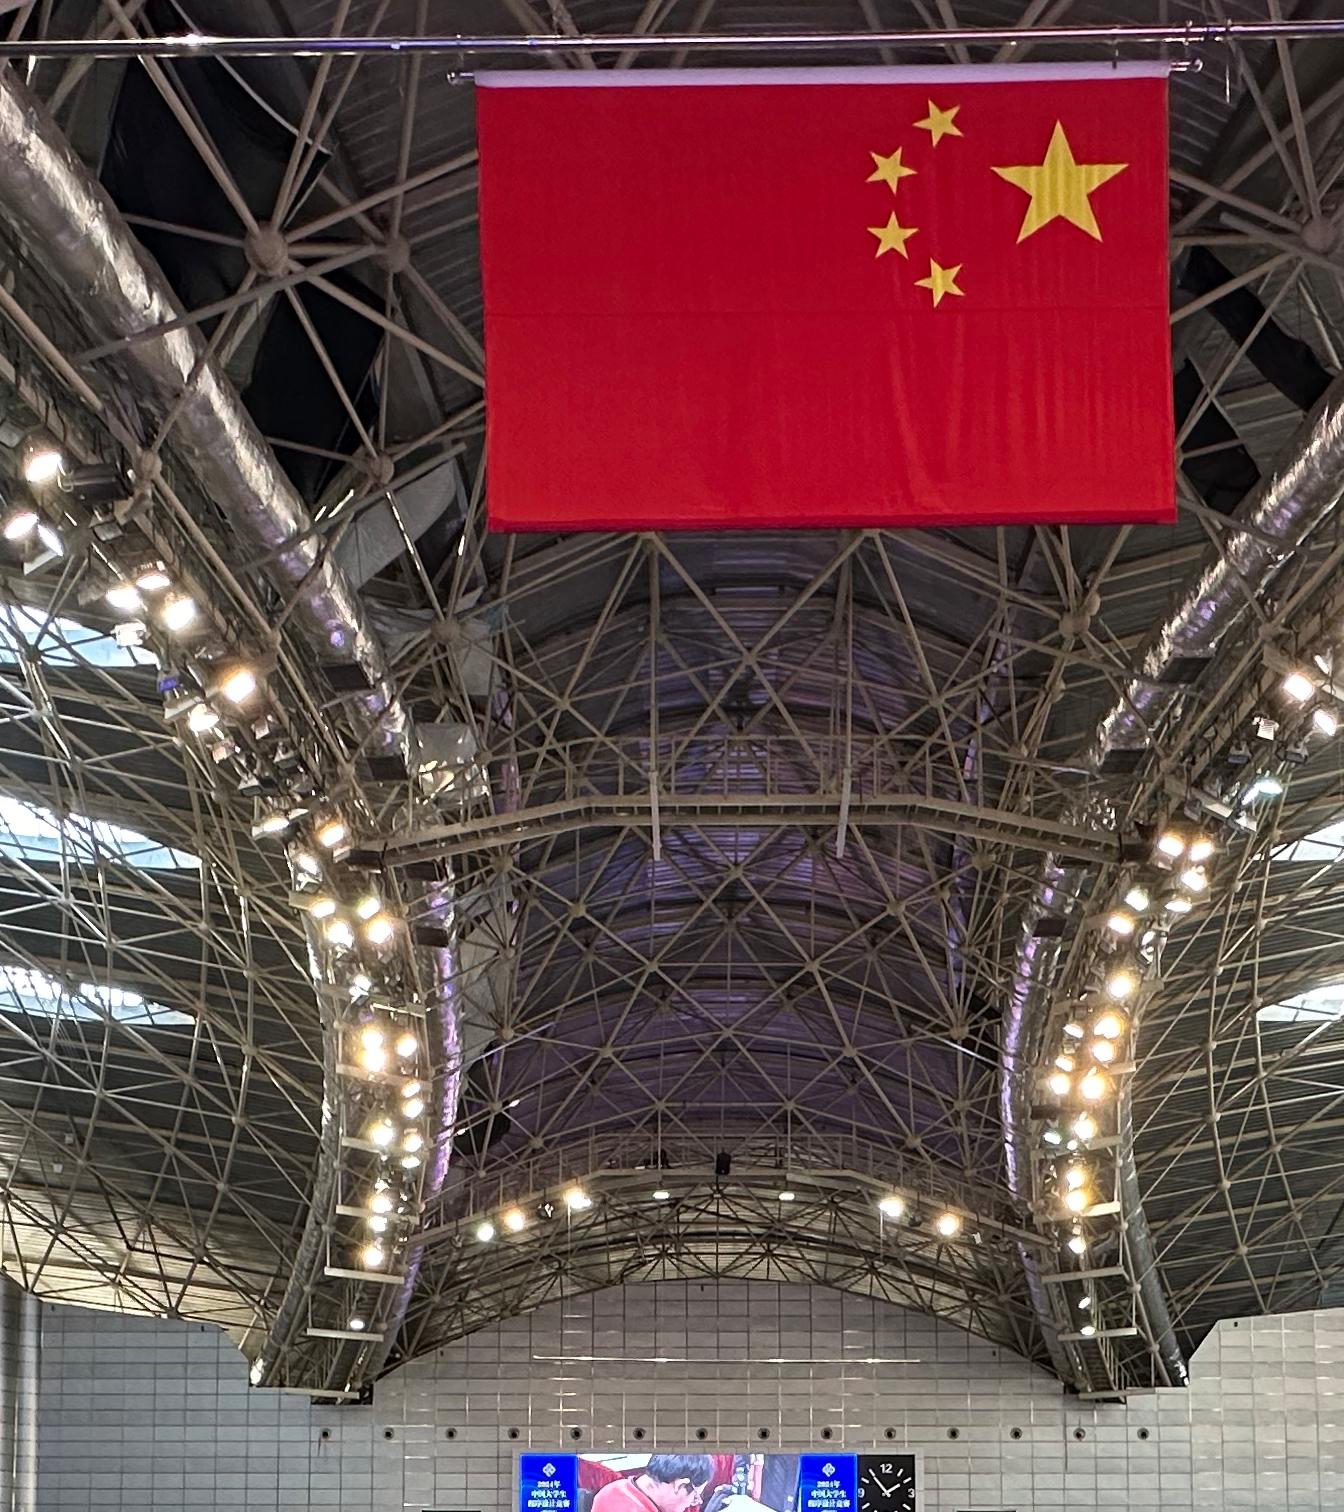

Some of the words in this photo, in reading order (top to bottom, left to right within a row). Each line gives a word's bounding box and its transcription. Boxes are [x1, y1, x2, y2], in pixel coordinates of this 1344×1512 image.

[879, 1463, 893, 1474] 12
[857, 1487, 865, 1498] 9
[908, 1487, 915, 1498] 3
